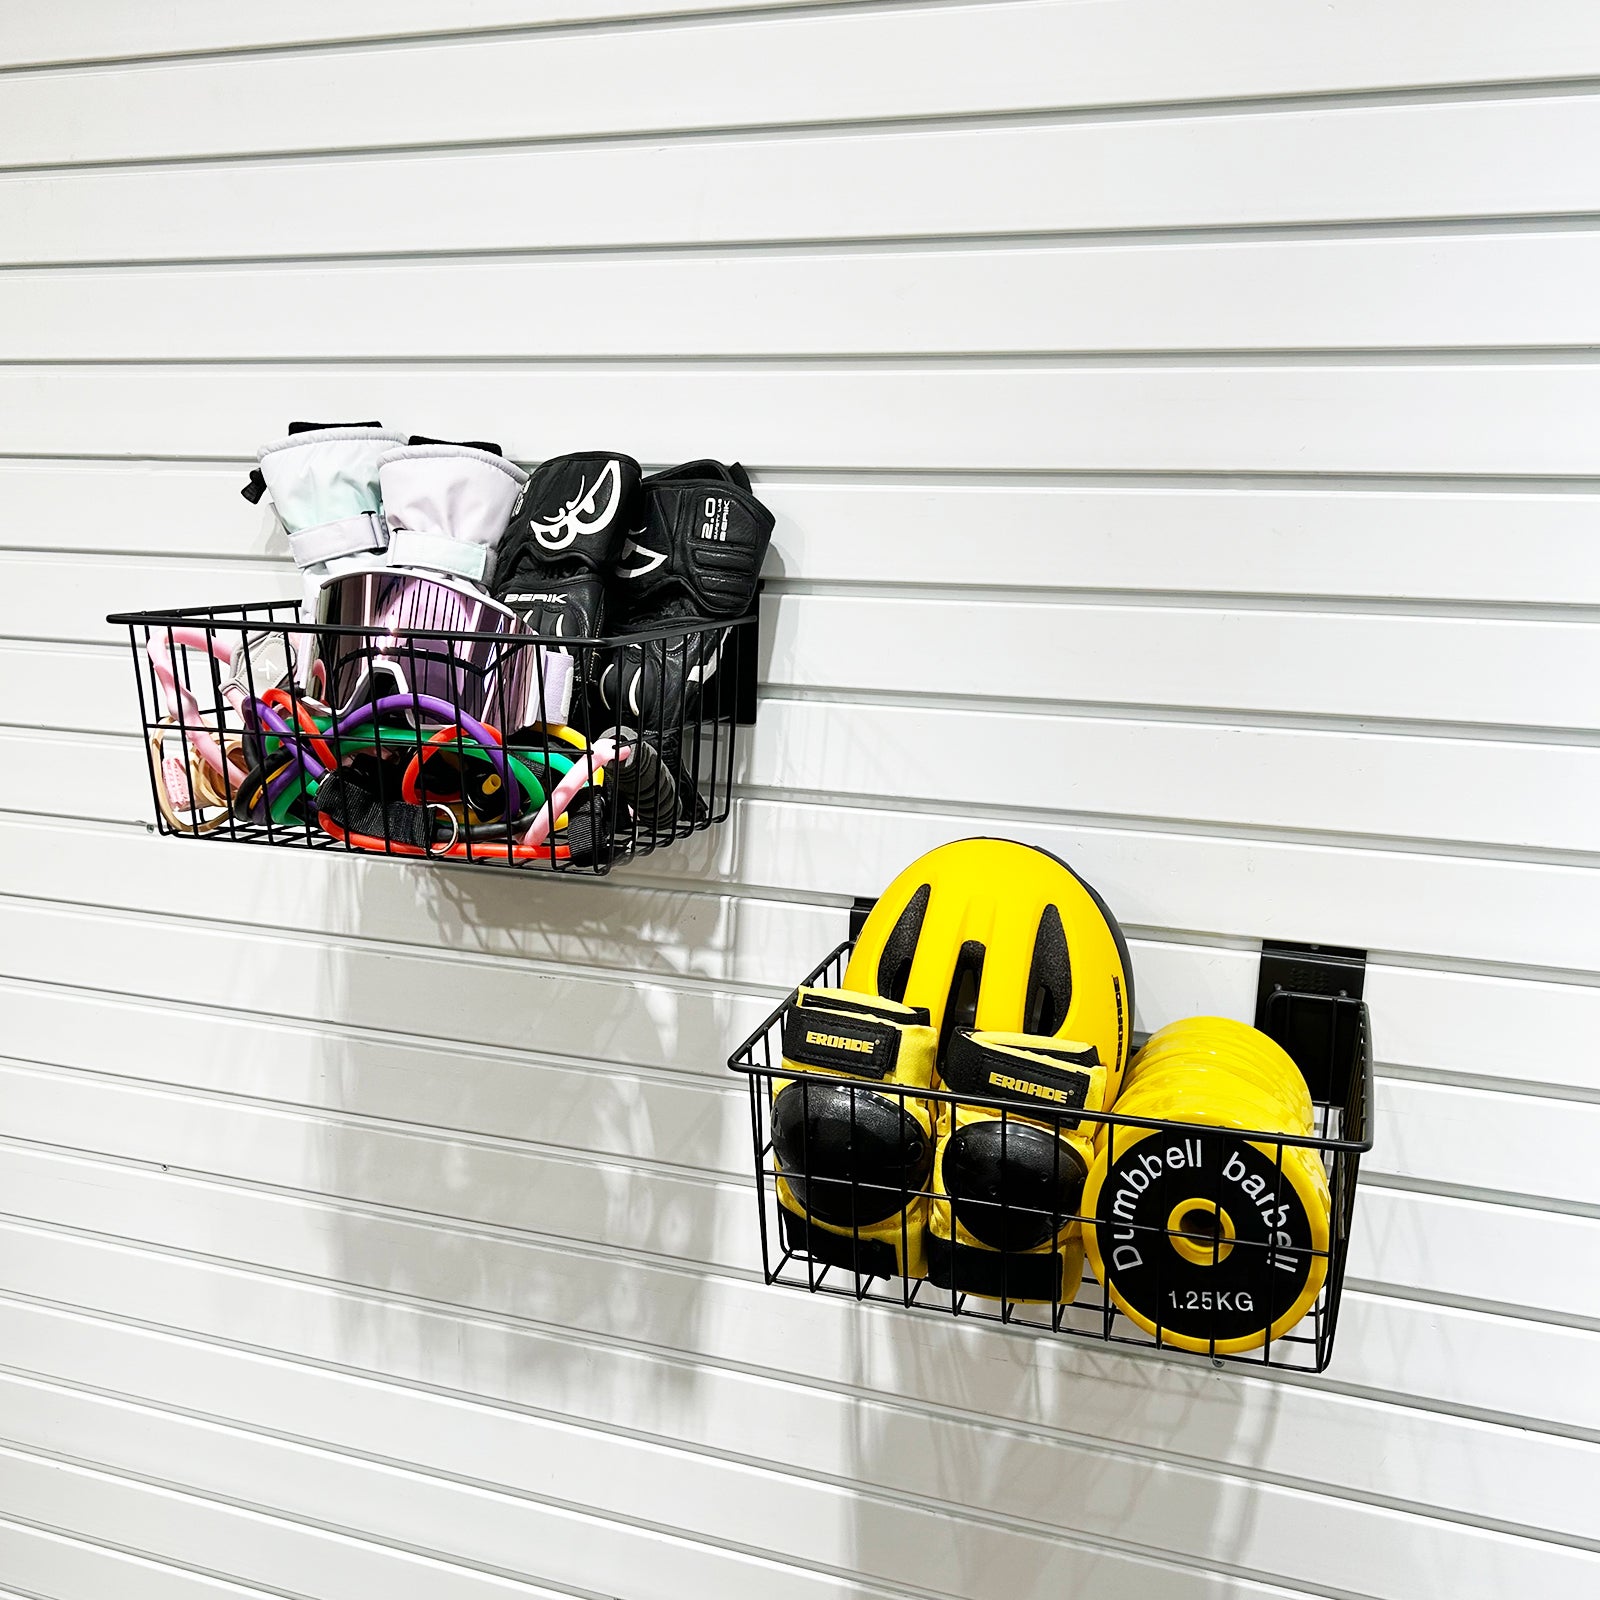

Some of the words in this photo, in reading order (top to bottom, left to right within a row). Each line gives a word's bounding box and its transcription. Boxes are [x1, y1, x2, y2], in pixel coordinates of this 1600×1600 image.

[701, 497, 716, 540] 2.0
[719, 500, 730, 541] BERIK
[504, 593, 568, 604] BERIK
[1112, 1139, 1202, 1271] Dumbbell
[1168, 1290, 1254, 1311] 1.25KG
